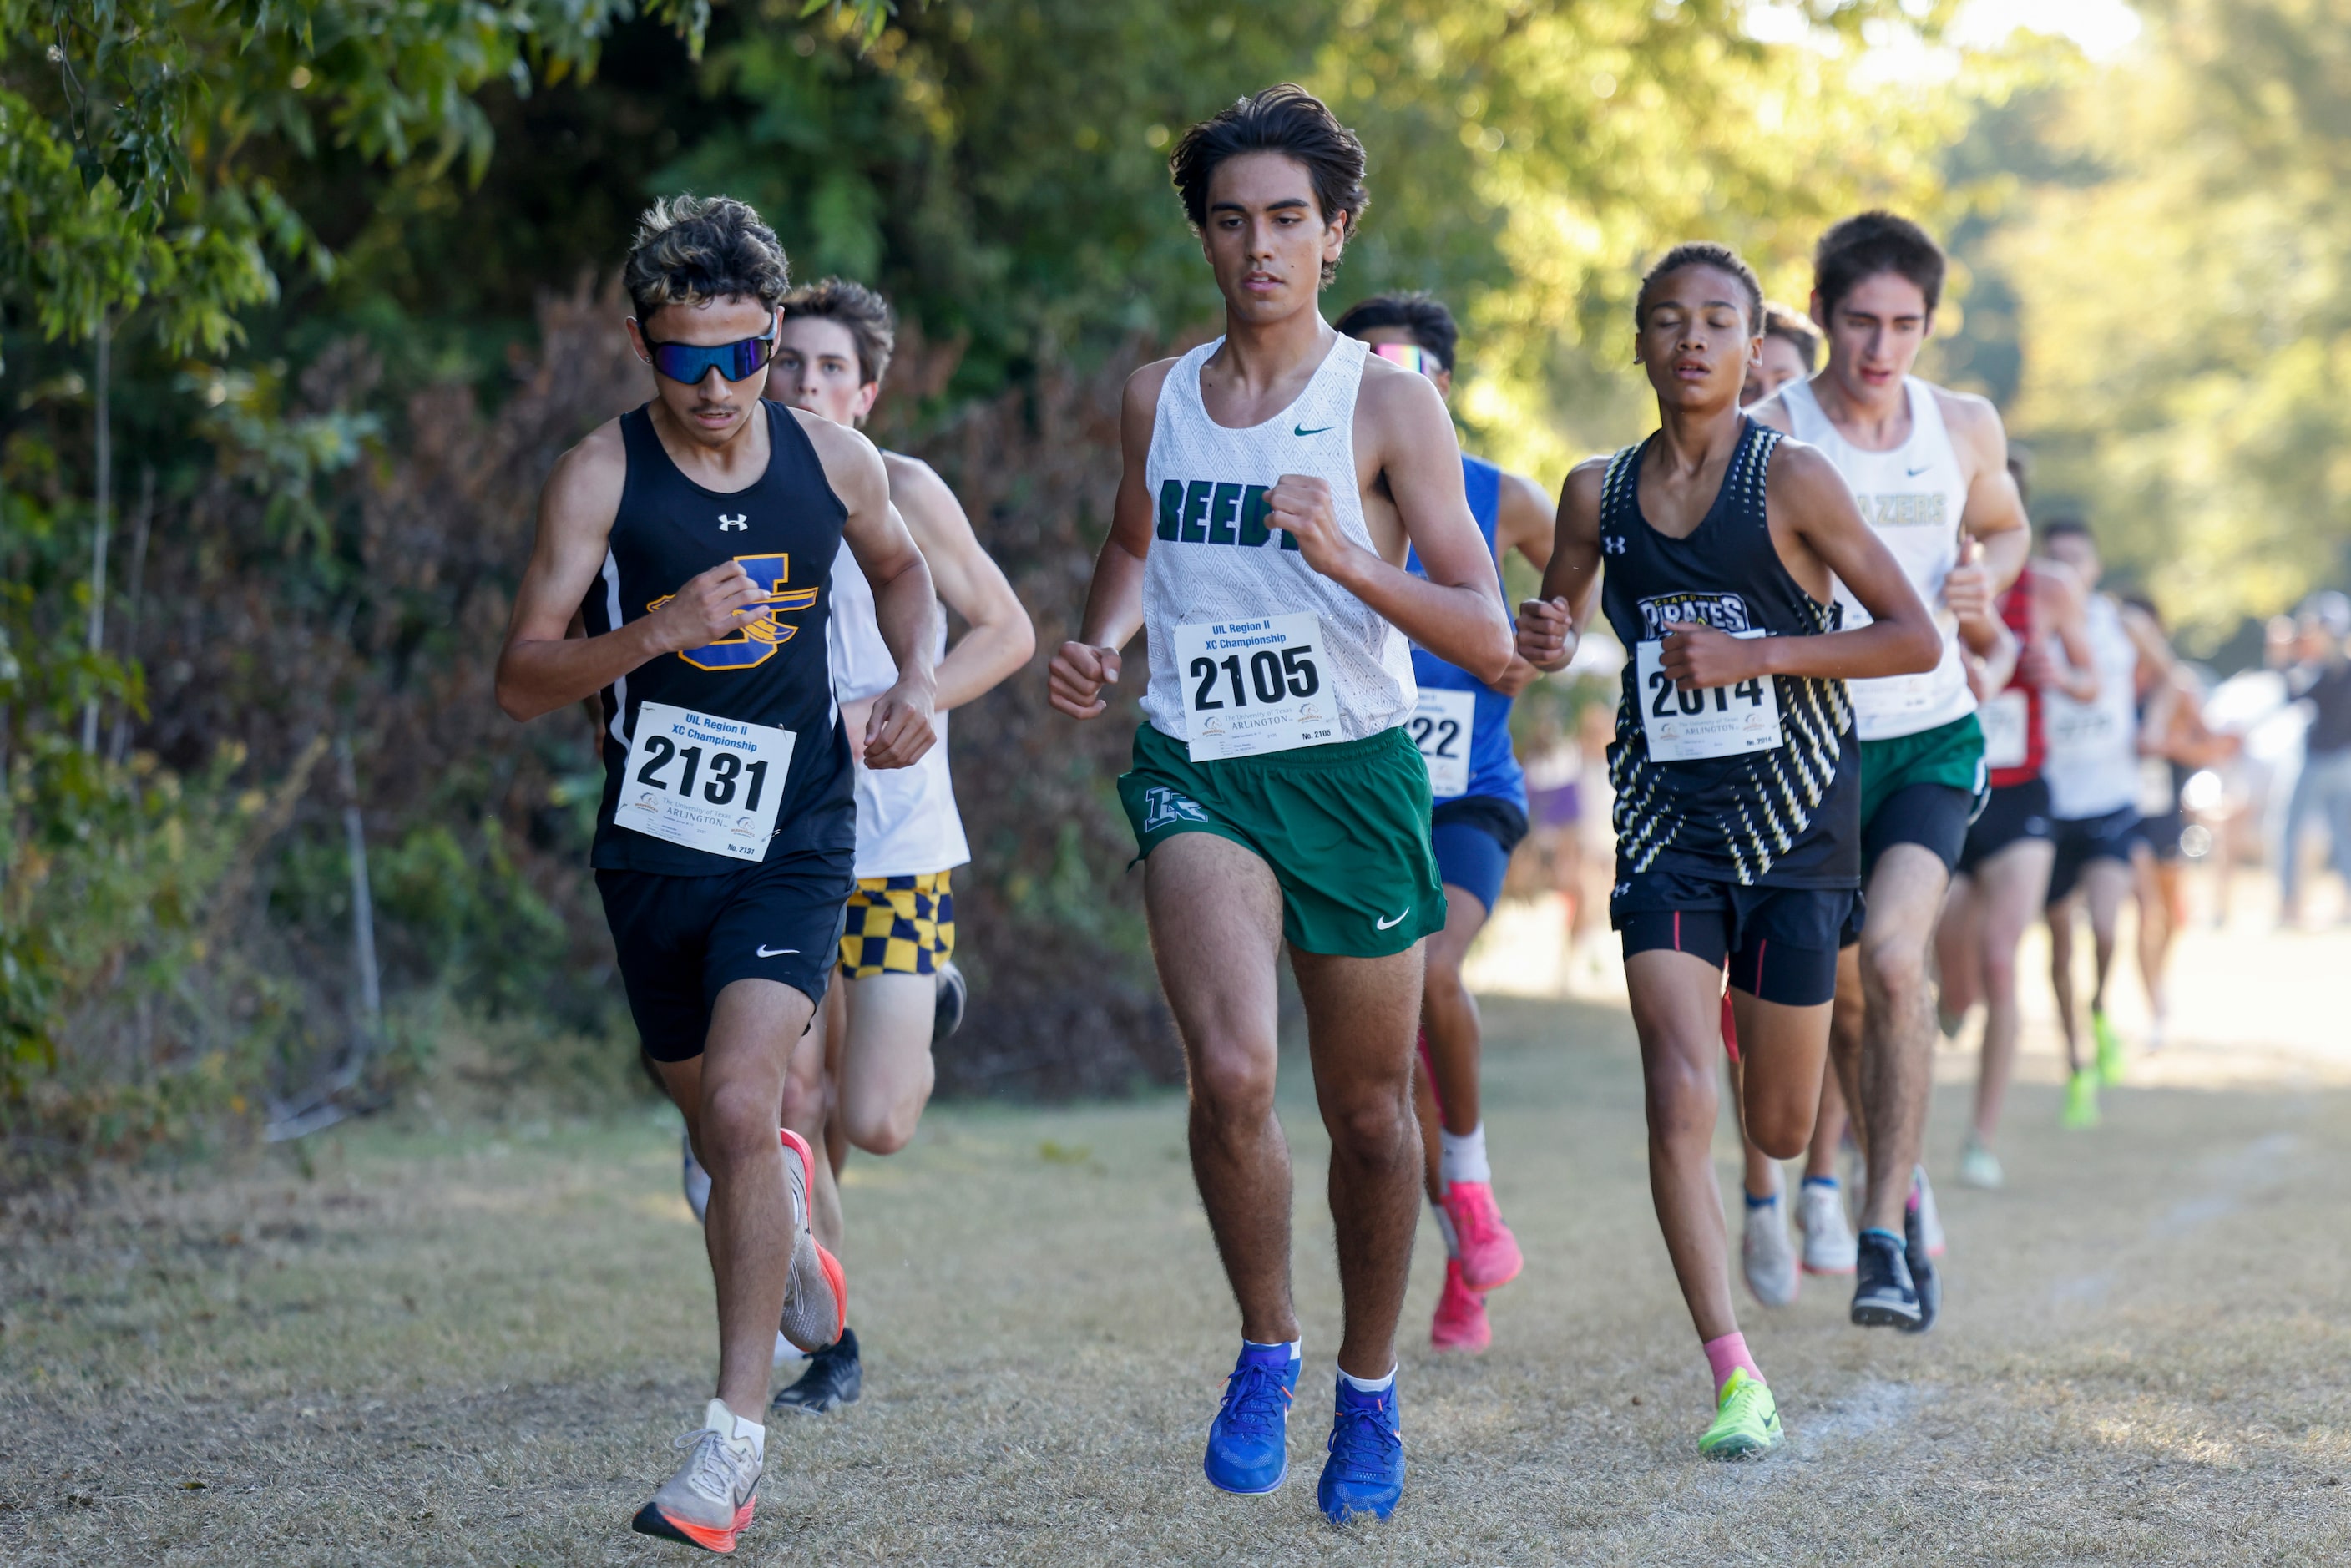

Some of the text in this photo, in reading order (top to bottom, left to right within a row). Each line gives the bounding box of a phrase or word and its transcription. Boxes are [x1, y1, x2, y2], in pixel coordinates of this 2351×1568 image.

[1157, 479, 1299, 551] REED
[1212, 620, 1271, 635] UIL Region II
[1641, 596, 1746, 640] PIRATES
[1205, 633, 1287, 650] XC Championship
[1190, 645, 1320, 711] 2105
[685, 713, 747, 735] UIL Region II
[1231, 715, 1288, 730] ARLINGTON
[1236, 711, 1266, 720] University
[671, 724, 757, 753] XC Championship
[1302, 729, 1331, 741] No. 2105
[1403, 717, 1459, 759] 22
[1686, 724, 1735, 736] ARLINGTON
[636, 735, 769, 812] 2131
[666, 807, 724, 827] ARLINGTON
[675, 801, 704, 814] University
[715, 811, 731, 819] Texas
[727, 844, 755, 855] No. 2131
